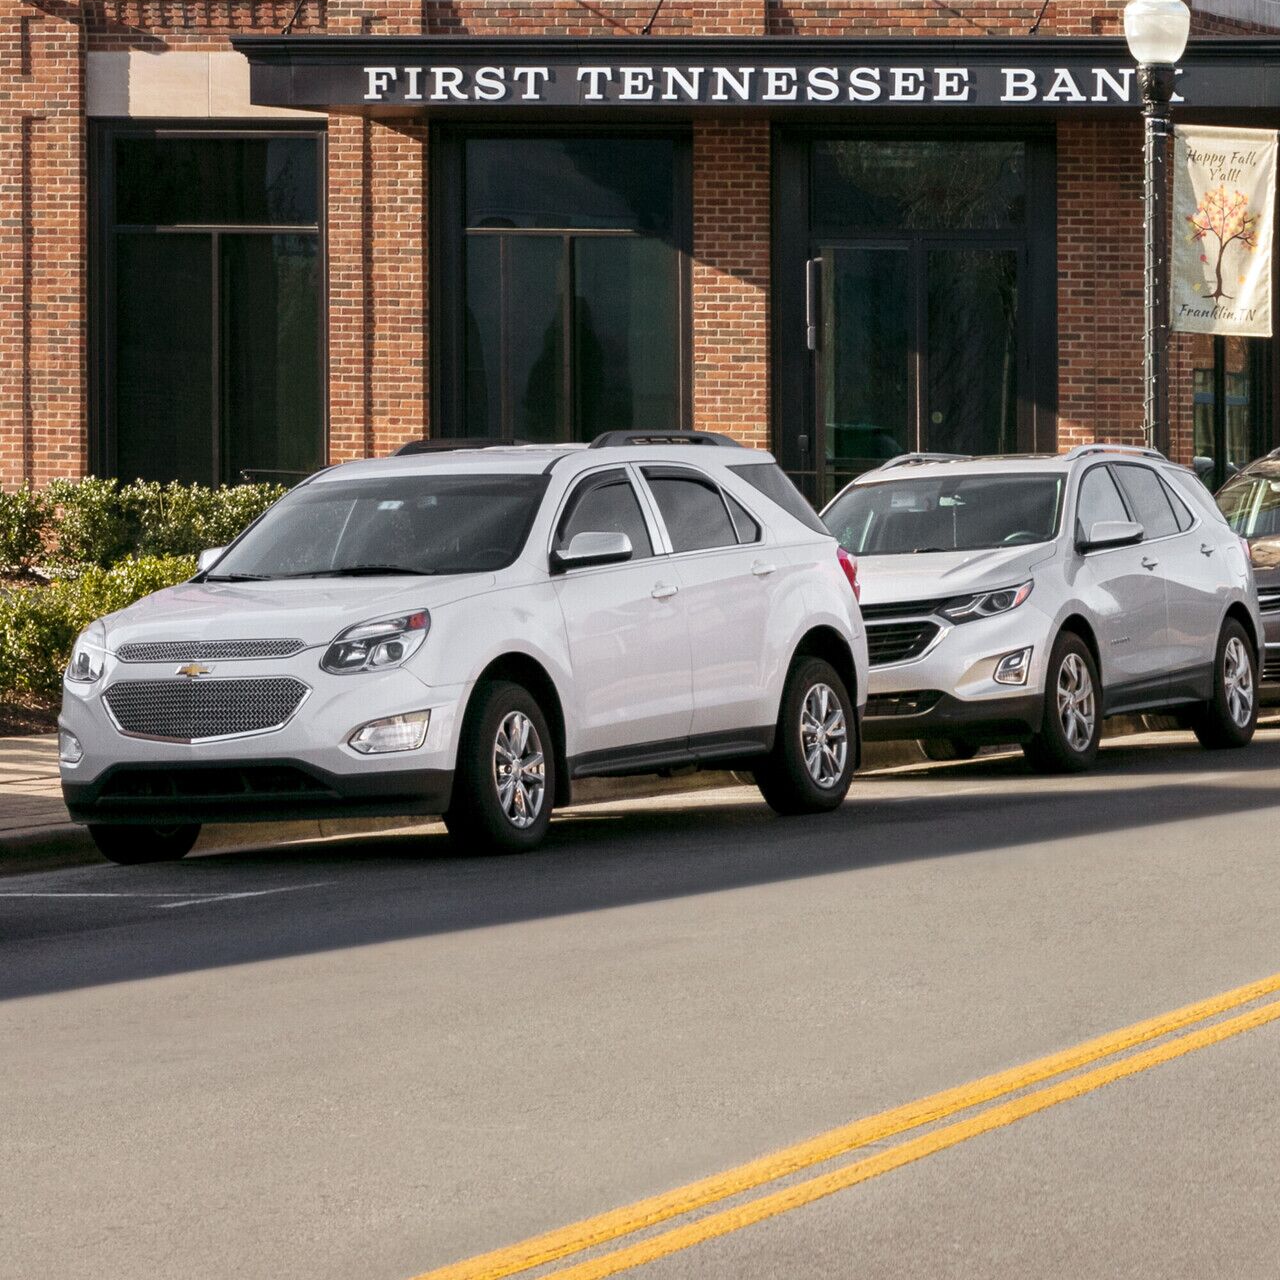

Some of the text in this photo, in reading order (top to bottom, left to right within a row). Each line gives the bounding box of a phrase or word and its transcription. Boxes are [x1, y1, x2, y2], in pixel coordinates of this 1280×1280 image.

[363, 66, 549, 101] FIRST
[576, 66, 970, 102] TENNESSEE
[1187, 149, 1257, 168] Happy Fall,
[1209, 168, 1241, 182] Y'all!
